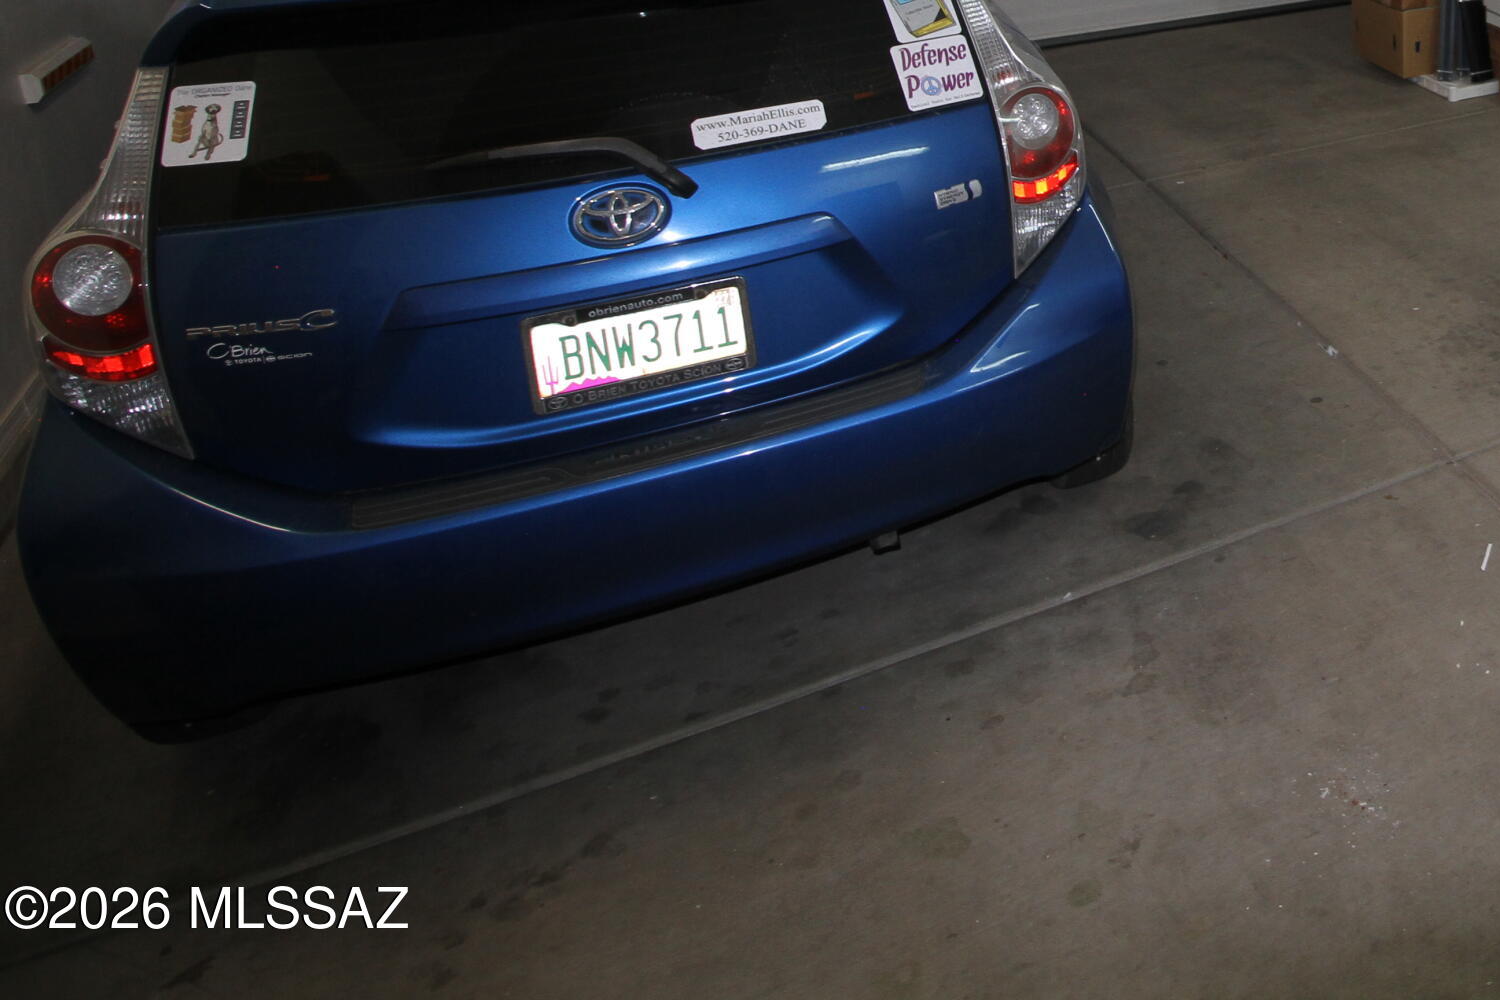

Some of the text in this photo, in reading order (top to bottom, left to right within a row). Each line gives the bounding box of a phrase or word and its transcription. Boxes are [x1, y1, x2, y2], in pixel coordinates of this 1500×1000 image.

[900, 43, 967, 72] Defense
[696, 104, 821, 132] www.MariahEllis.com
[717, 119, 808, 143] 520-369-DANE
[588, 291, 684, 319] obrienauto.com
[558, 306, 738, 381] BNW3711
[631, 373, 681, 391] TOYOTA
